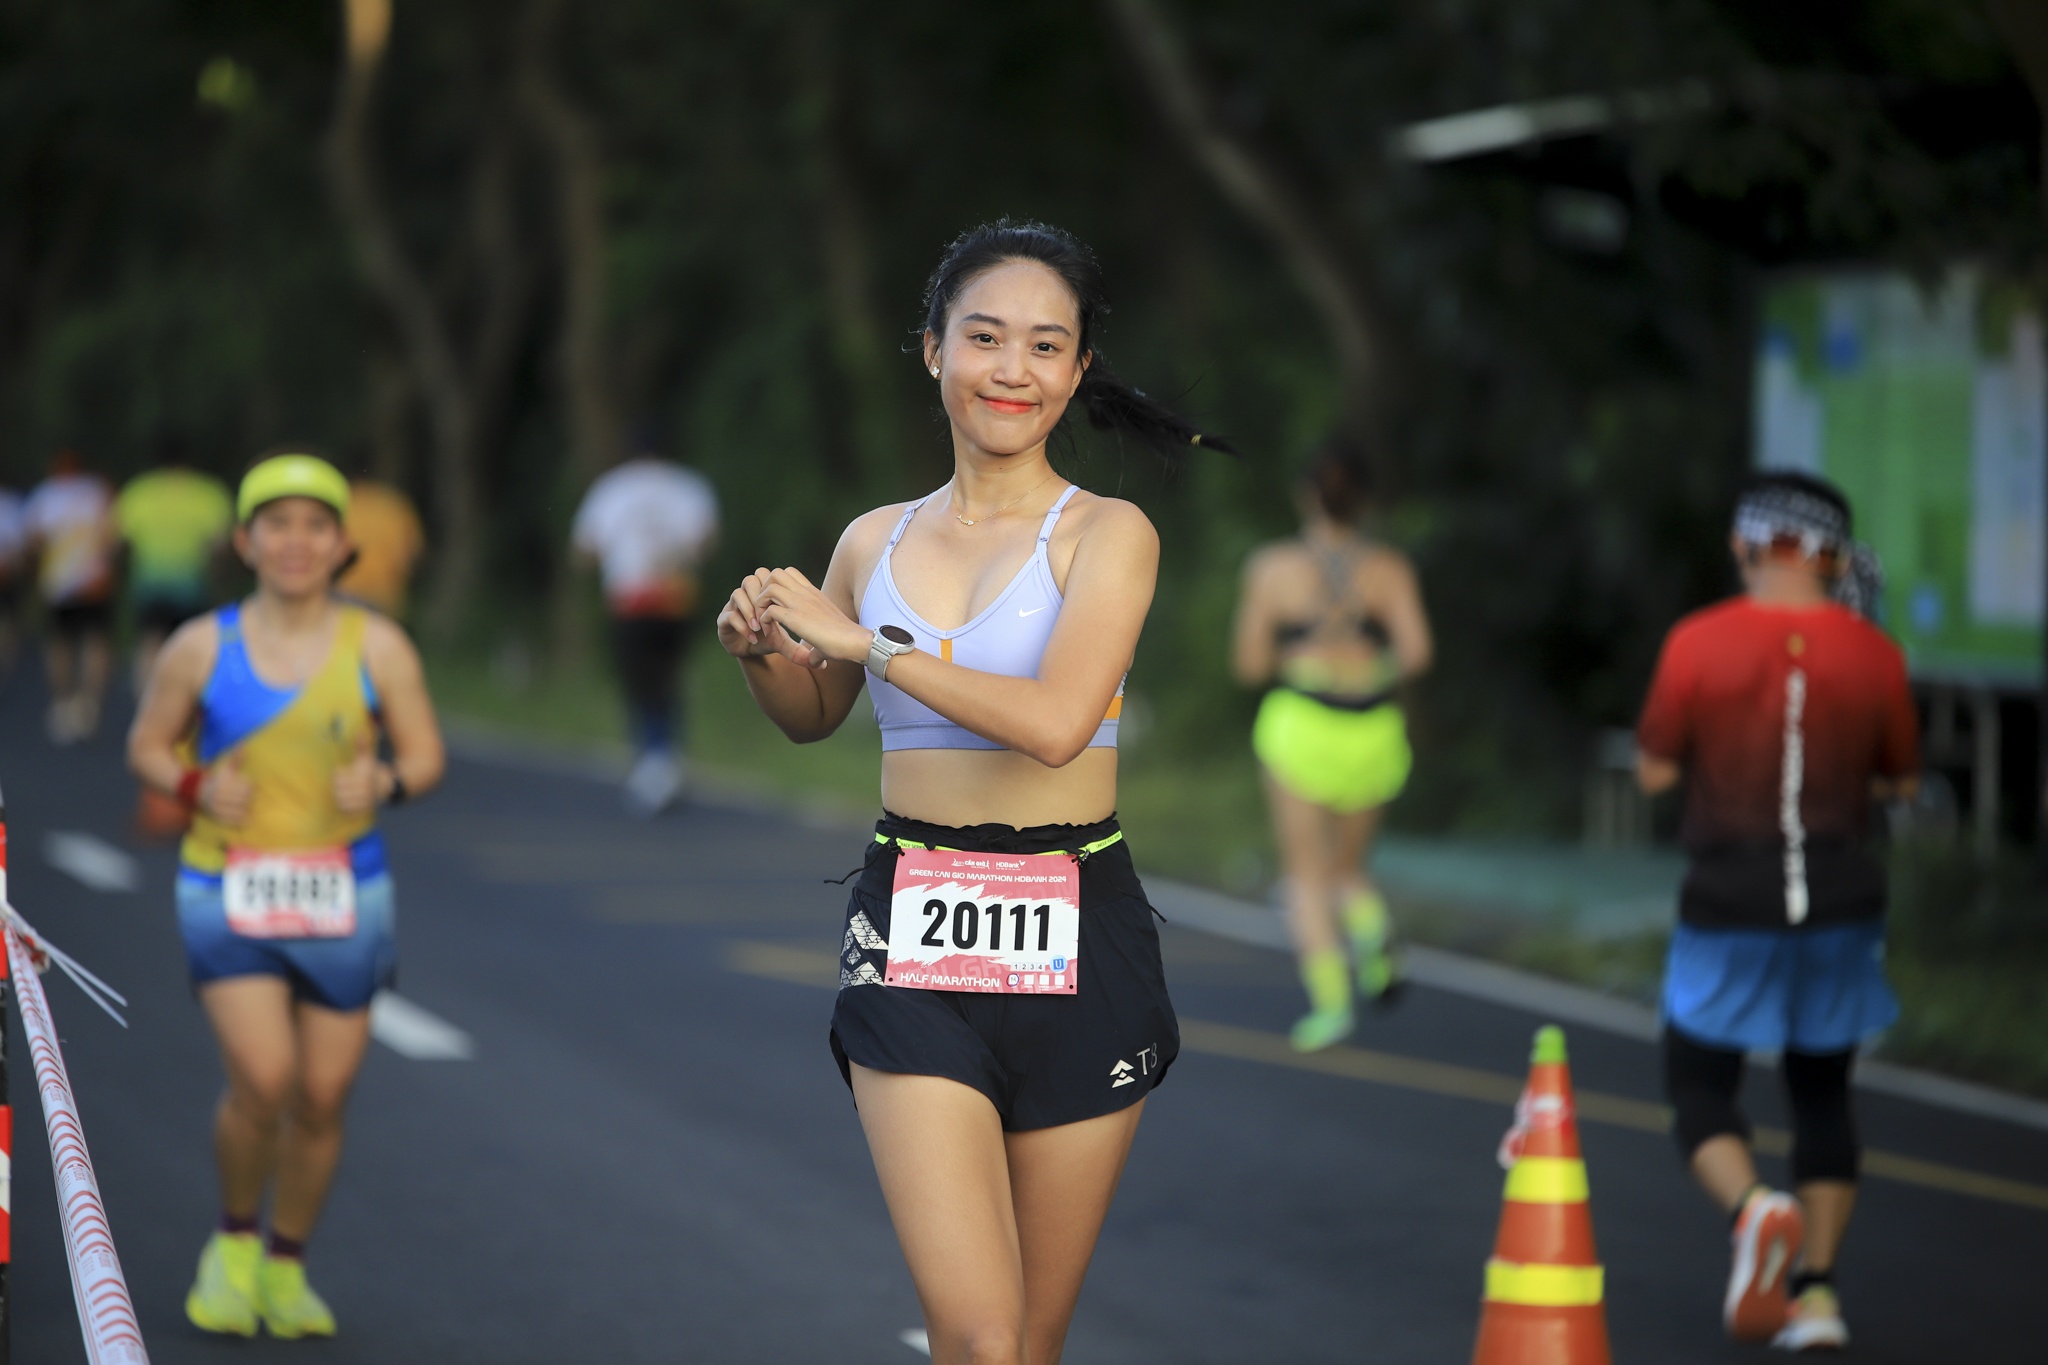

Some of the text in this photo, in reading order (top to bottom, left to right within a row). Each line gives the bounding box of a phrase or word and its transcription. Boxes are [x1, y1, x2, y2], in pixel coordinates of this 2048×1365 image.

[909, 868, 933, 877] GREEN
[934, 870, 950, 878] CAN
[966, 873, 1013, 882] MARATHON
[1013, 875, 1048, 883] HDBANK
[1048, 875, 1067, 883] 2024
[920, 898, 1050, 951] 20111
[900, 972, 1000, 988] HALF MARATHON
[1136, 1042, 1158, 1076] T8
